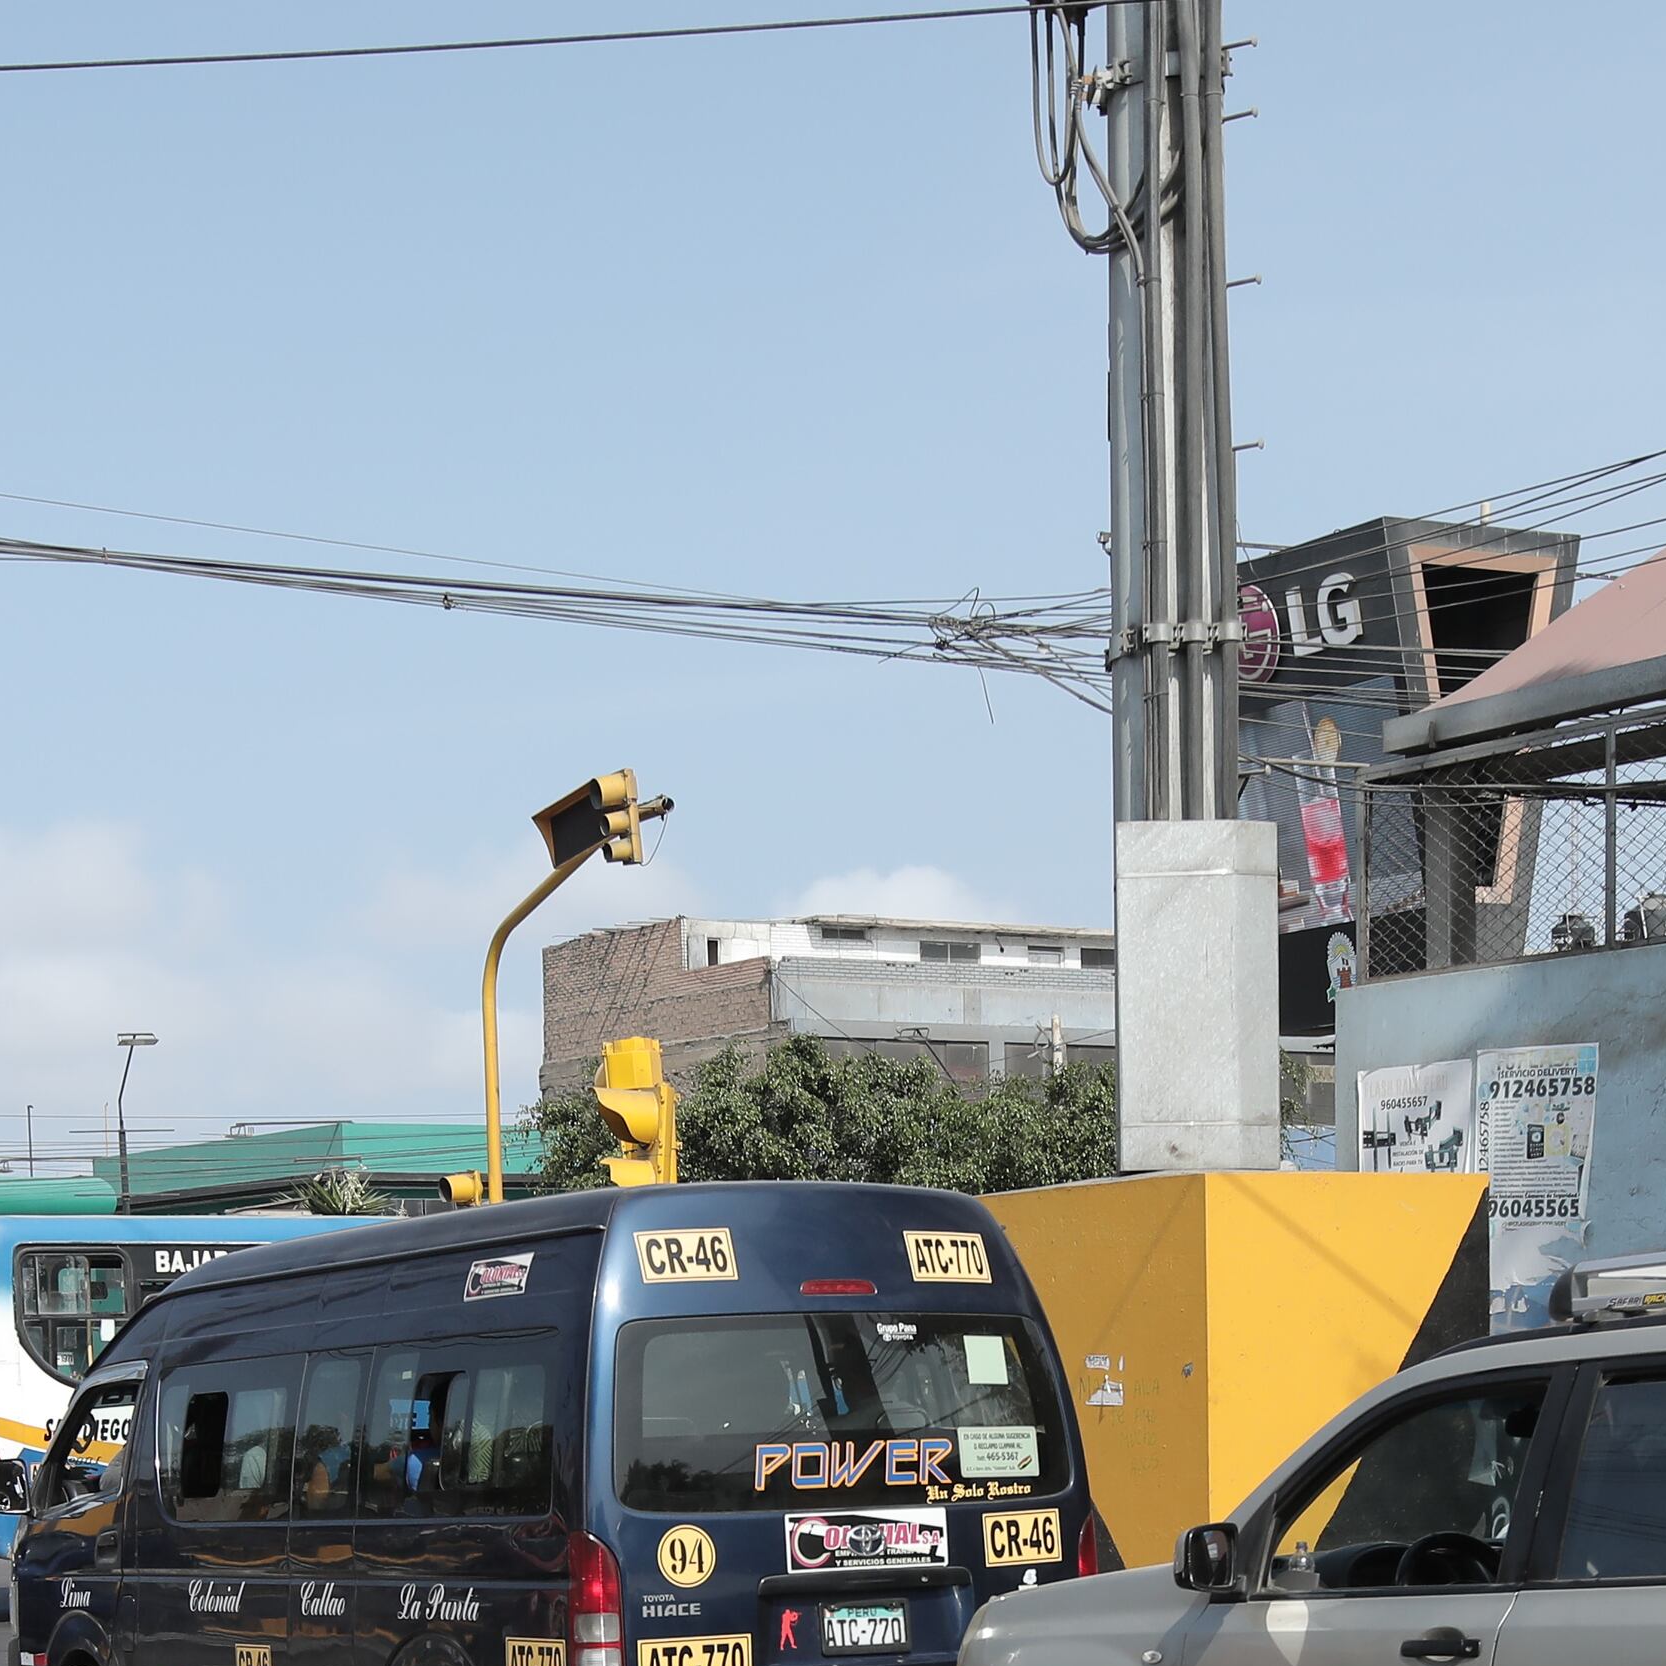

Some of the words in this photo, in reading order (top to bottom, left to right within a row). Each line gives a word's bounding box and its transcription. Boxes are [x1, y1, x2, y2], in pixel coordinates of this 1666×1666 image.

[1285, 572, 1364, 658] LG
[1380, 1095, 1428, 1110] 960455657
[1489, 1076, 1595, 1099] 912465758
[1479, 1101, 1490, 1172] 12465758
[1489, 1199, 1579, 1217] 96045565
[645, 1235, 728, 1276] CR-46
[913, 1238, 984, 1276] ATC-770
[876, 1322, 898, 1335] Grupo
[754, 1438, 953, 1492] POWER
[986, 1452, 1019, 1461] 465-5367
[951, 1483, 984, 1501] Solo
[986, 1481, 1032, 1500] Rostro
[990, 1516, 1055, 1559] CR-46
[669, 1538, 704, 1575] 94
[843, 1558, 885, 1567] SERVICIOS
[886, 1556, 932, 1565] GENERALES
[60, 1577, 91, 1608] Lima
[188, 1581, 246, 1613] Colonial
[300, 1581, 346, 1616] Callao
[396, 1583, 421, 1621] La
[425, 1583, 480, 1622] Punta
[643, 1594, 675, 1602] TOYOTA
[642, 1602, 701, 1618] HIACE
[847, 1608, 877, 1618] PERU
[826, 1617, 903, 1647] ATC-770
